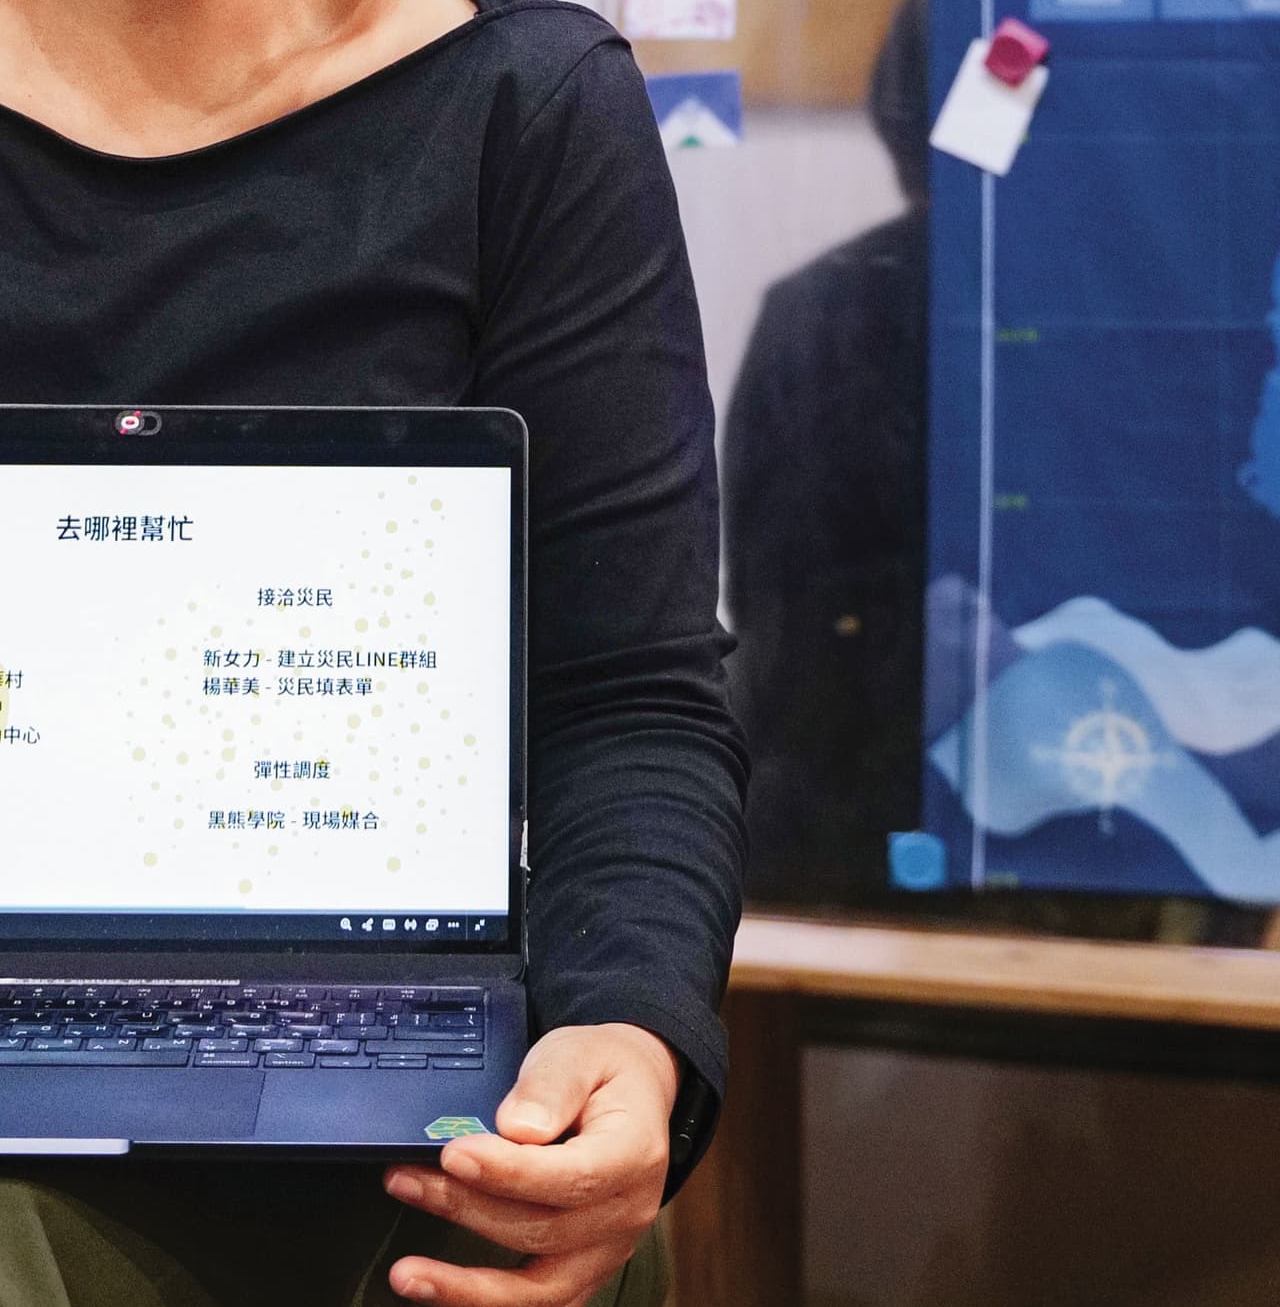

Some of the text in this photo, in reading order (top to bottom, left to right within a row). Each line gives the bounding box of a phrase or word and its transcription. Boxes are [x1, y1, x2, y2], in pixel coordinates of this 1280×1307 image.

[56, 514, 194, 542] 去哪裡幫忙
[257, 588, 333, 607] 接洽災民
[203, 649, 260, 668] 新女力
[278, 649, 437, 669] 建立災民LINE群組
[202, 676, 260, 696] 楊華美
[278, 677, 373, 697] 災民填表單
[254, 760, 330, 780] 彈性調度
[208, 810, 285, 830] 黑熊學院
[303, 810, 379, 830] 現場媒合
